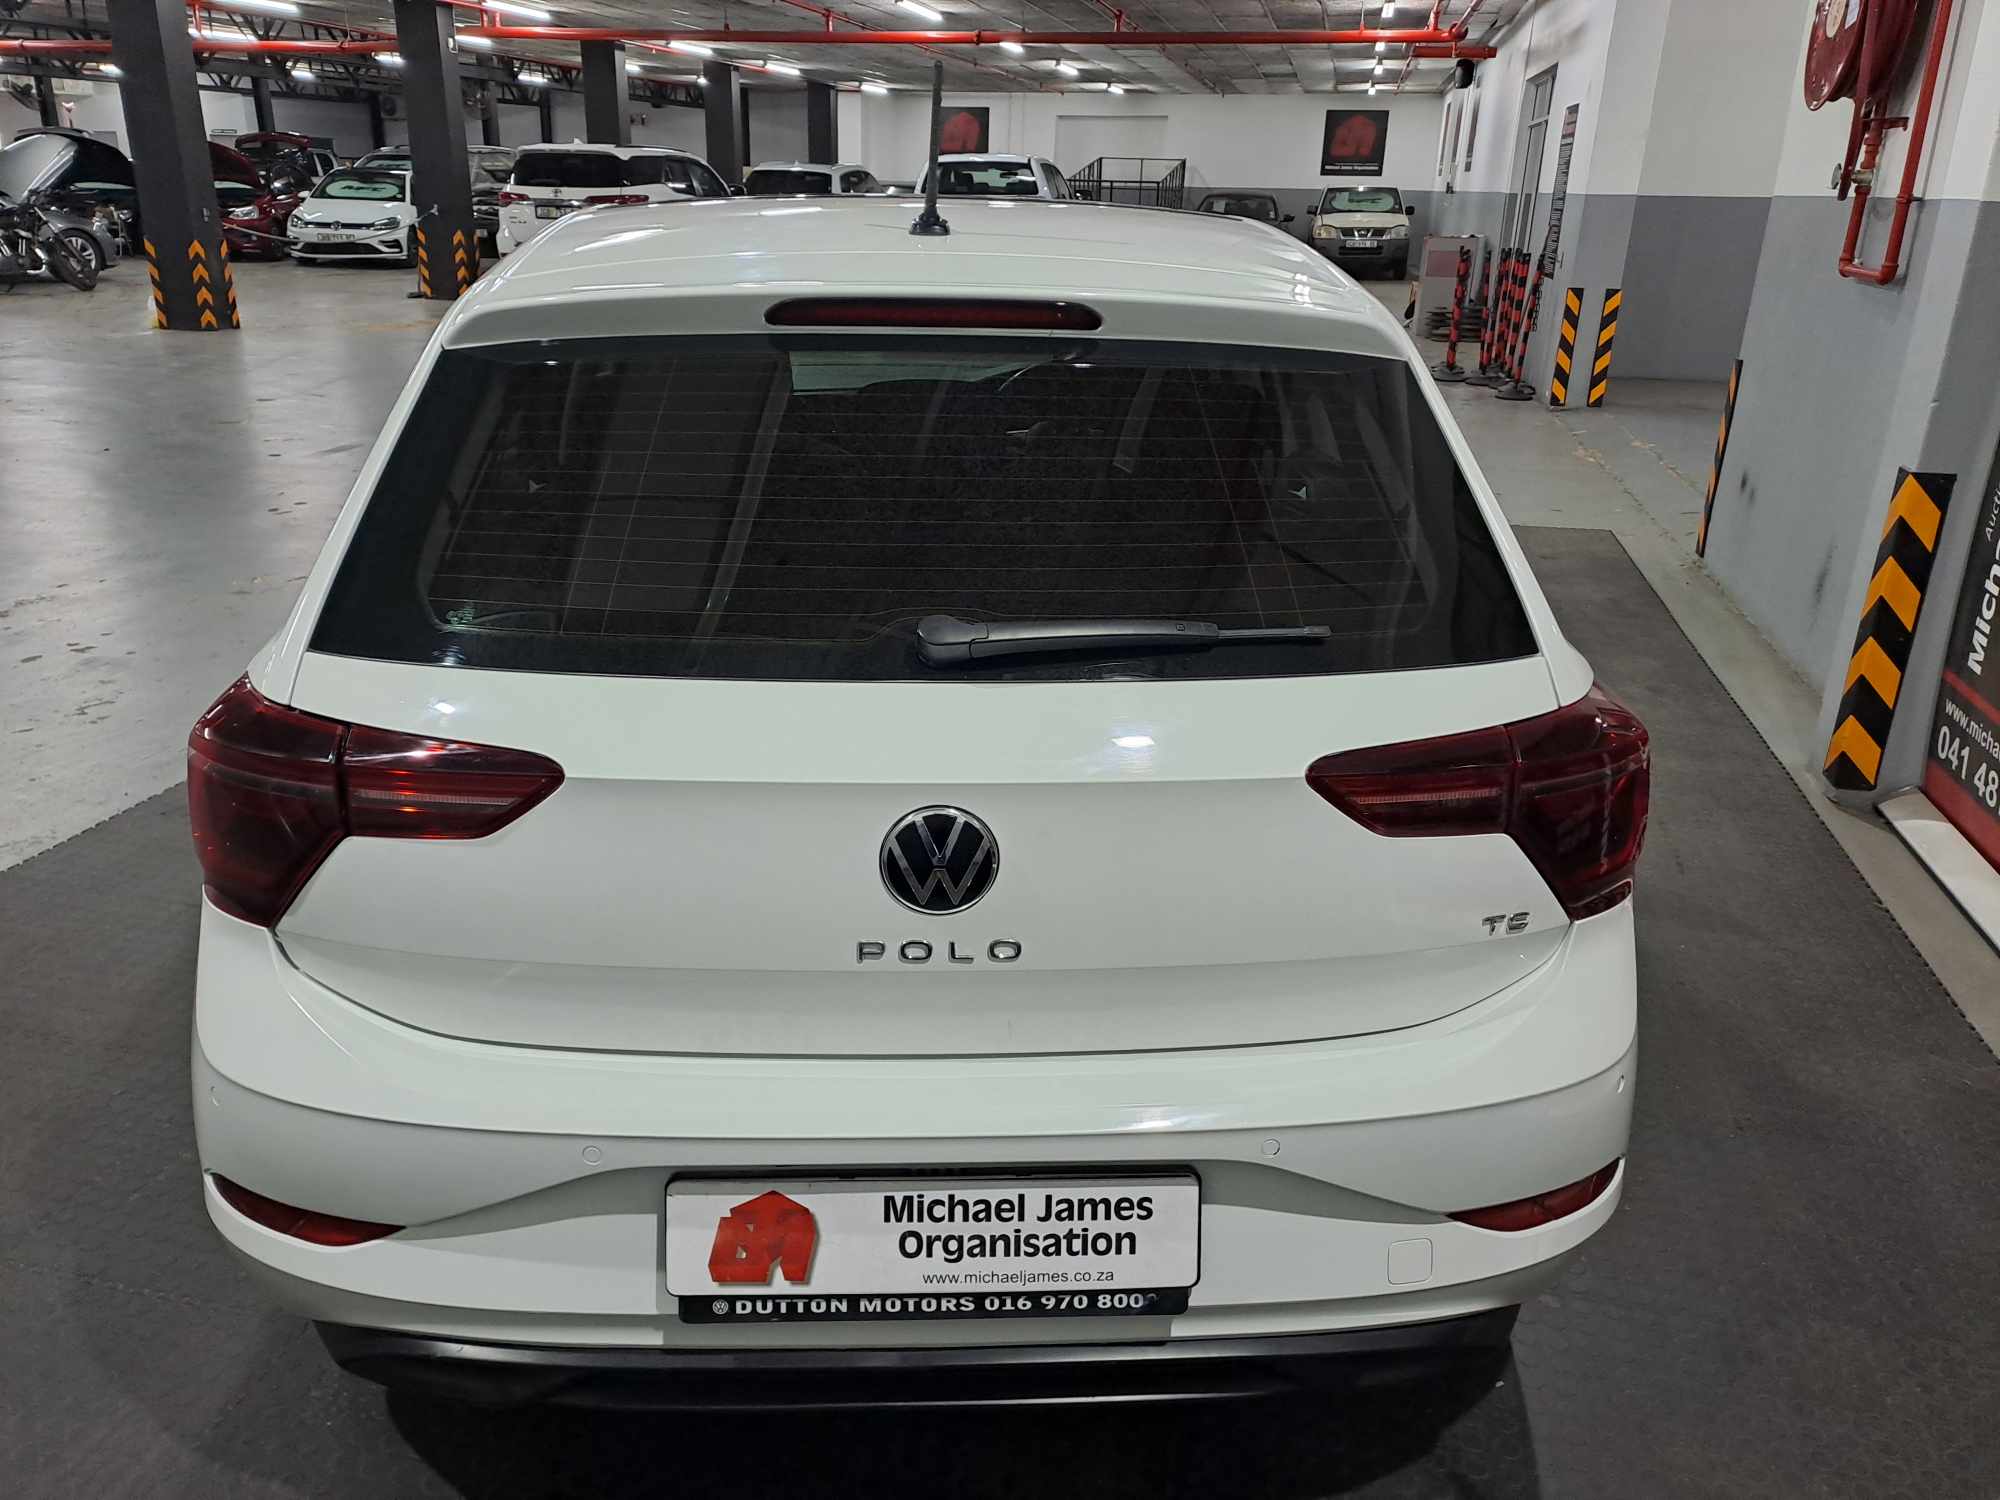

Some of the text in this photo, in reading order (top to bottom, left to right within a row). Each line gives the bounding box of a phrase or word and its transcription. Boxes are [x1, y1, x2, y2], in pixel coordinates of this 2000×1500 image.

[1967, 540, 2000, 676] Mich
[1945, 699, 2000, 762] www.micha
[1937, 725, 2000, 816] 041 48
[856, 938, 1022, 964] POLO
[883, 1193, 1154, 1223] Michael James
[898, 1227, 1137, 1263] Organisation
[922, 1269, 1114, 1286] www.michaeljames.co.za
[735, 1298, 848, 1314] DUTTON
[859, 1297, 975, 1313] MOTORS
[984, 1295, 1032, 1311] 016
[1040, 1294, 1088, 1310] 970
